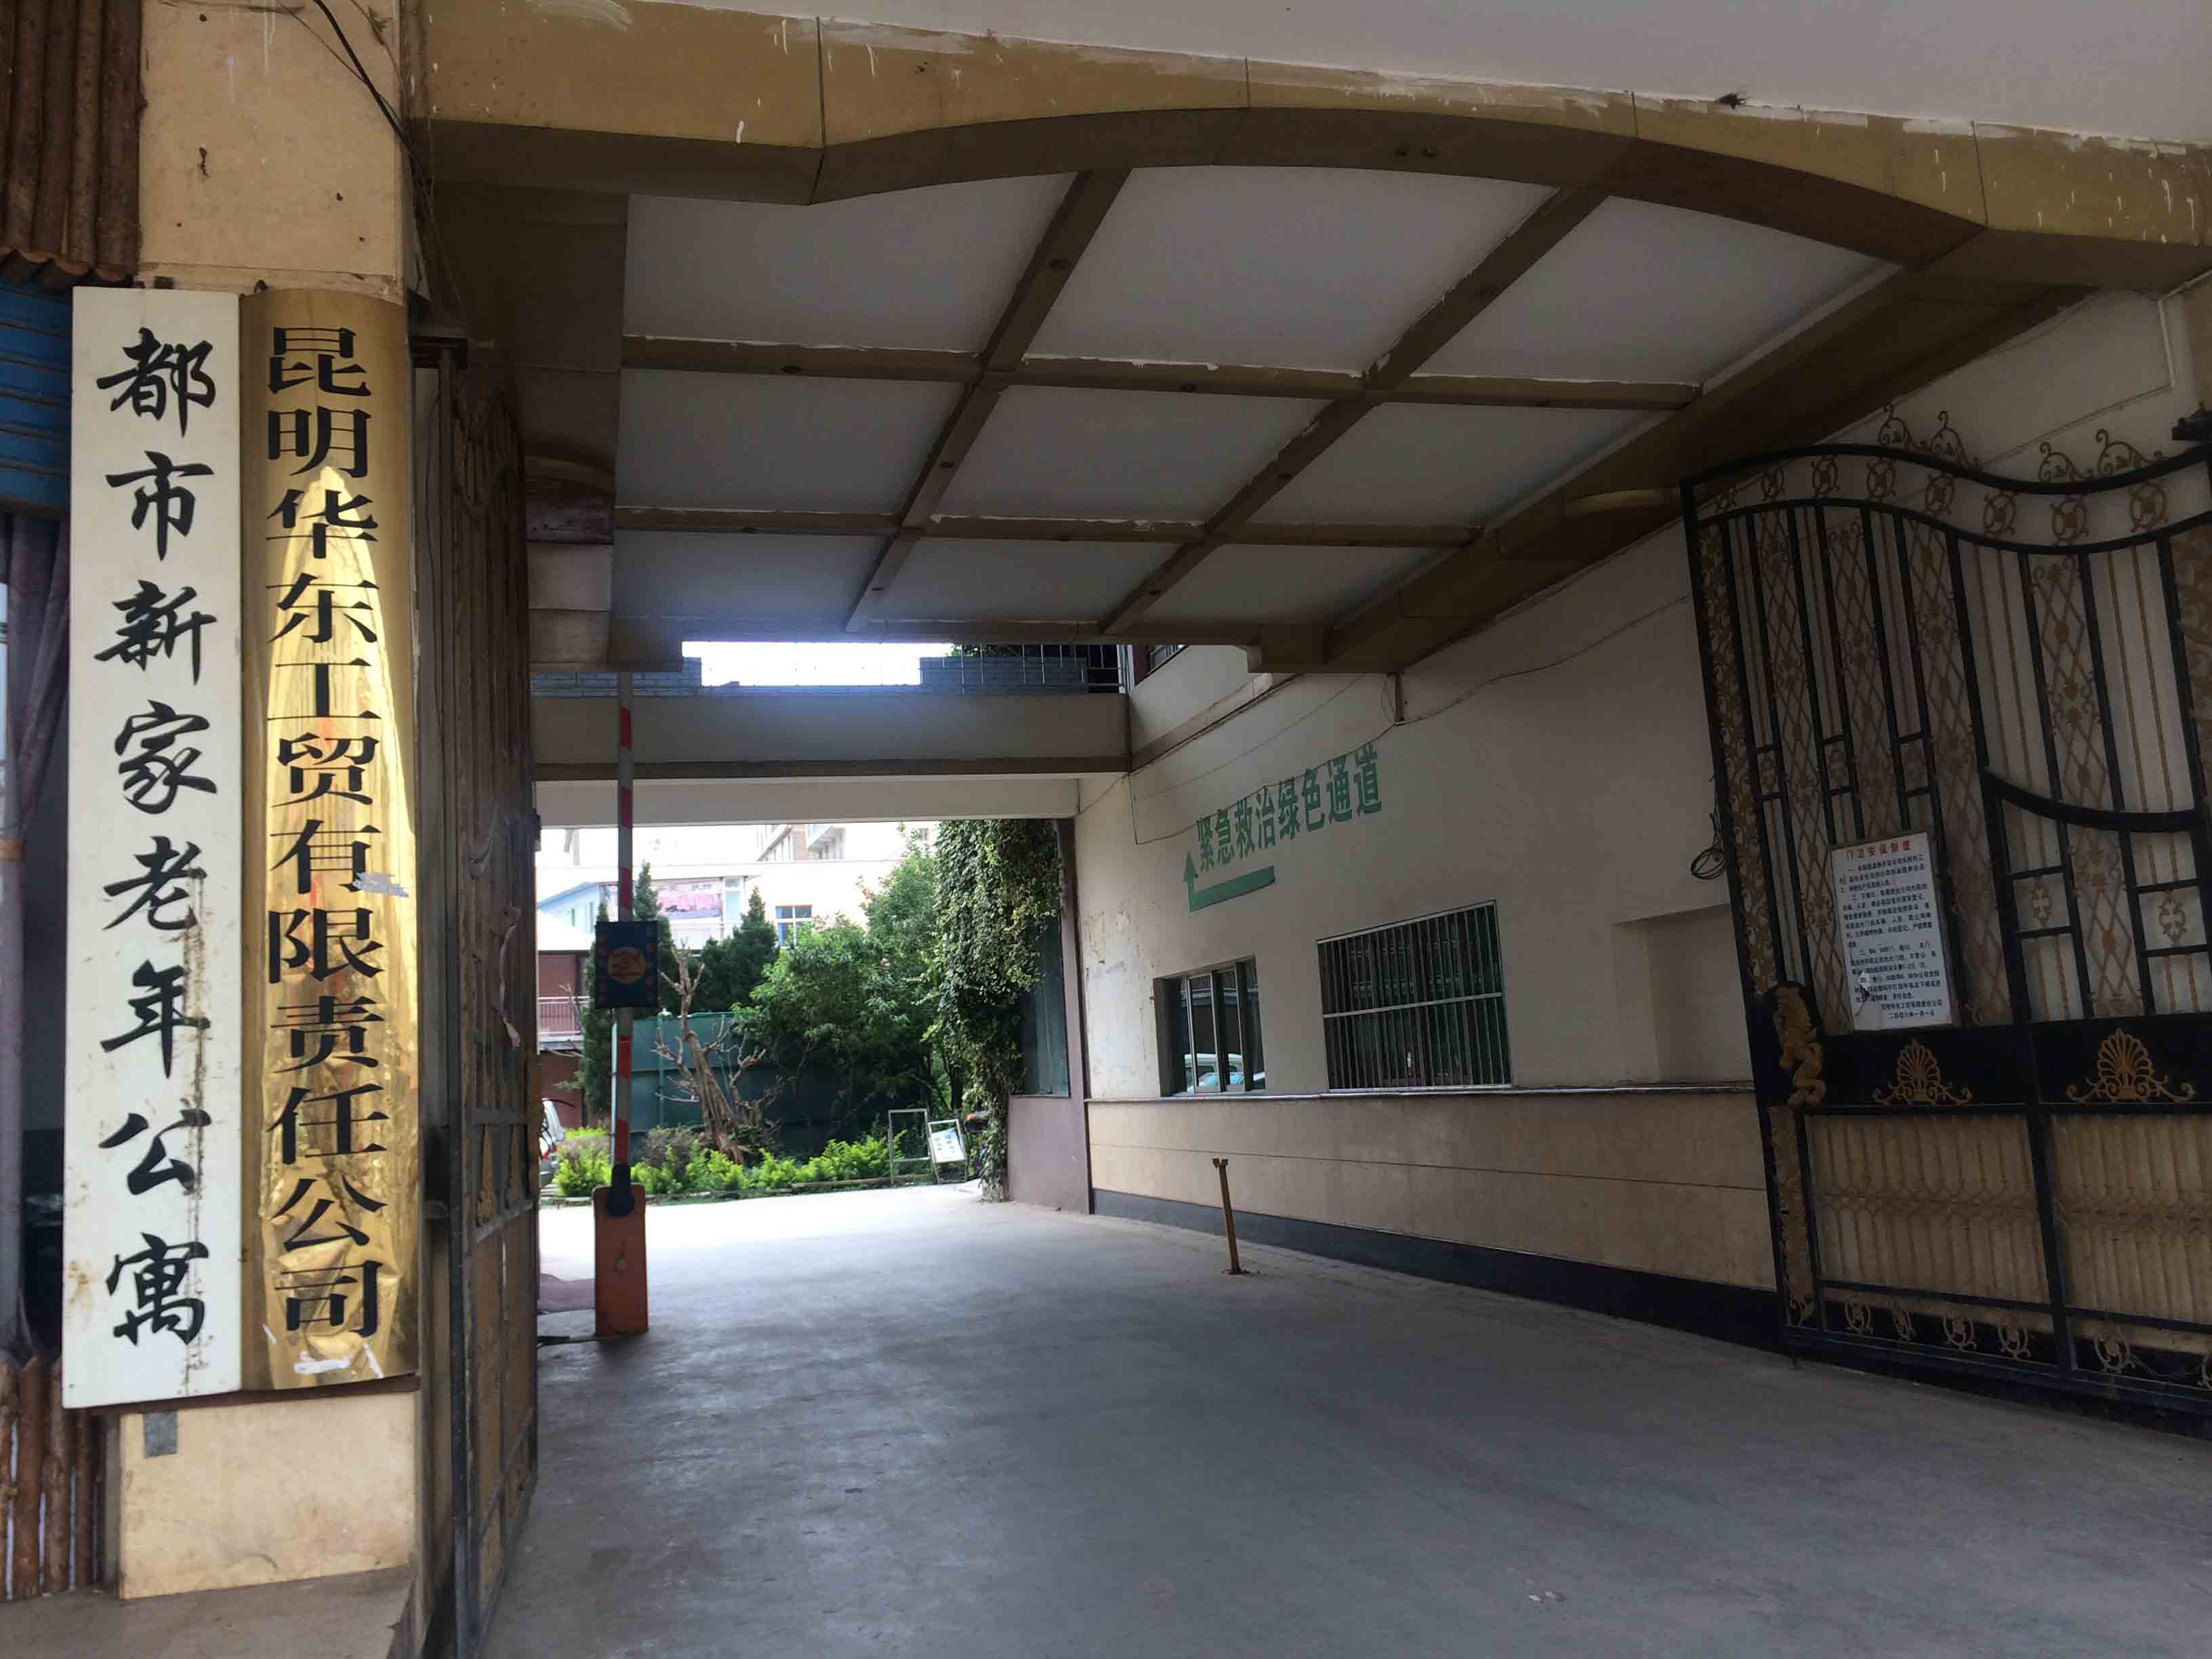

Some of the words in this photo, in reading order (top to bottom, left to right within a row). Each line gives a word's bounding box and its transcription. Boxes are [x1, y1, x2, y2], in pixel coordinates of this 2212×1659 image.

[93, 327, 218, 1345] 都市新家老年公寓
[265, 326, 388, 1339] 昆明华东工贸有限责任公司
[1196, 742, 1382, 872] 紧急救治绿色通道
